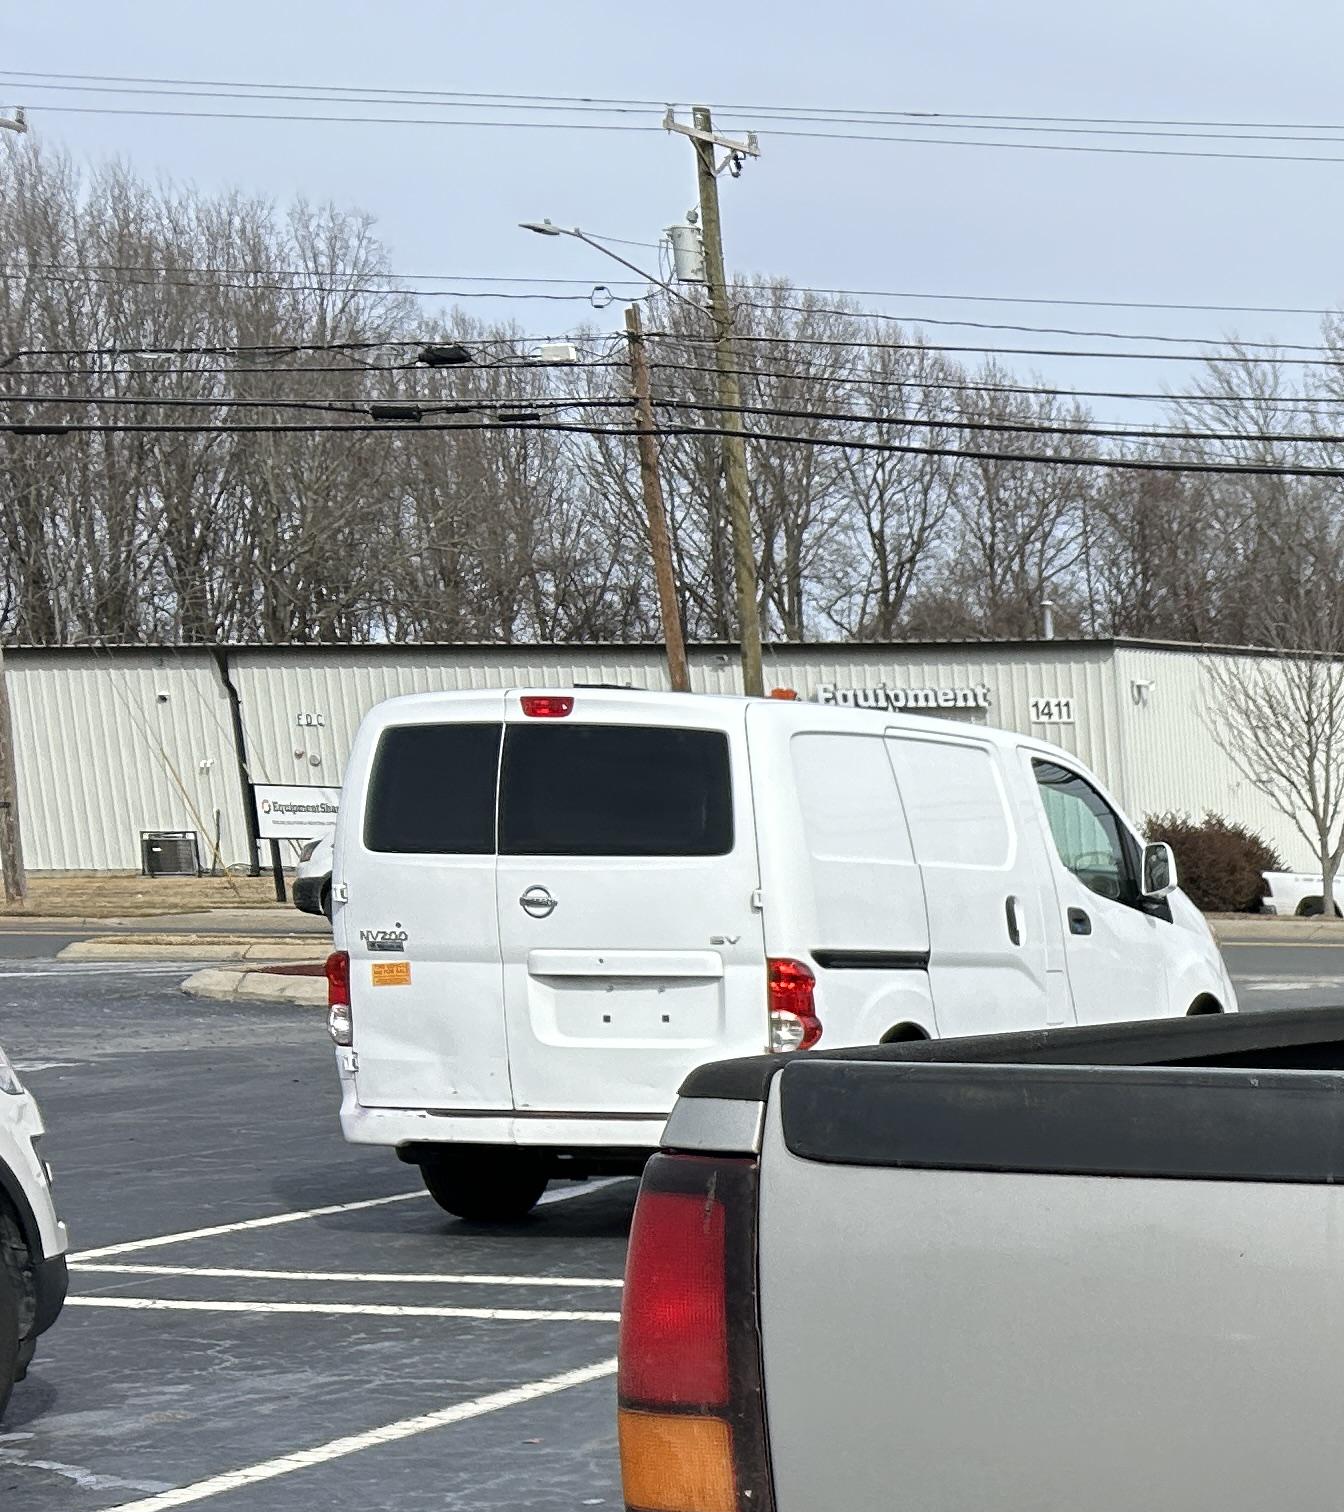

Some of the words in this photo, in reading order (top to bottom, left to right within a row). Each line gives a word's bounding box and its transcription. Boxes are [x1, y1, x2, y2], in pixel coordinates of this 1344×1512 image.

[815, 682, 992, 713] Equipment
[1031, 700, 1073, 720] 1411
[272, 801, 340, 815] EquipmentShar
[360, 930, 409, 941] NV200
